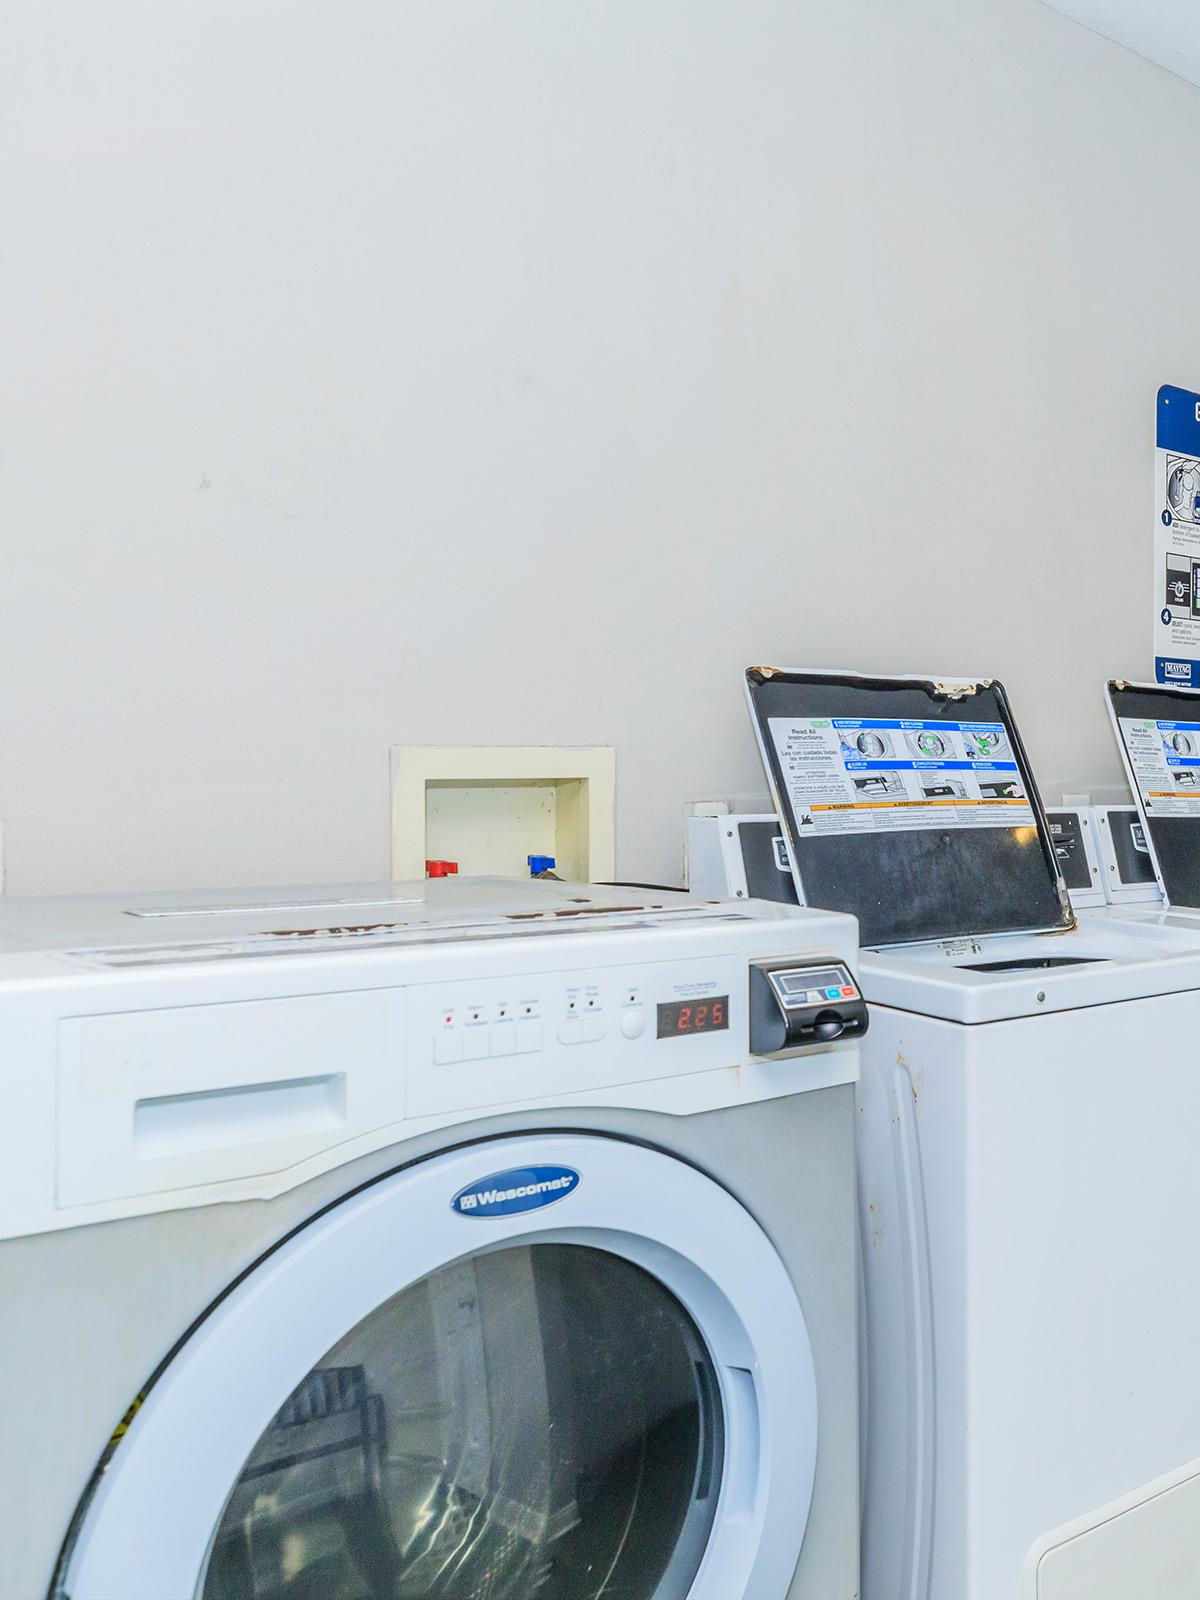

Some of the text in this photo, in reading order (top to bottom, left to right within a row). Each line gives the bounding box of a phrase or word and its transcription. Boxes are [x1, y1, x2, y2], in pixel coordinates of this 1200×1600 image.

[1164, 512, 1168, 524] 1
[1163, 610, 1169, 622] 4
[1166, 664, 1190, 674] MAYTAG
[477, 1176, 571, 1206] Wascomat
